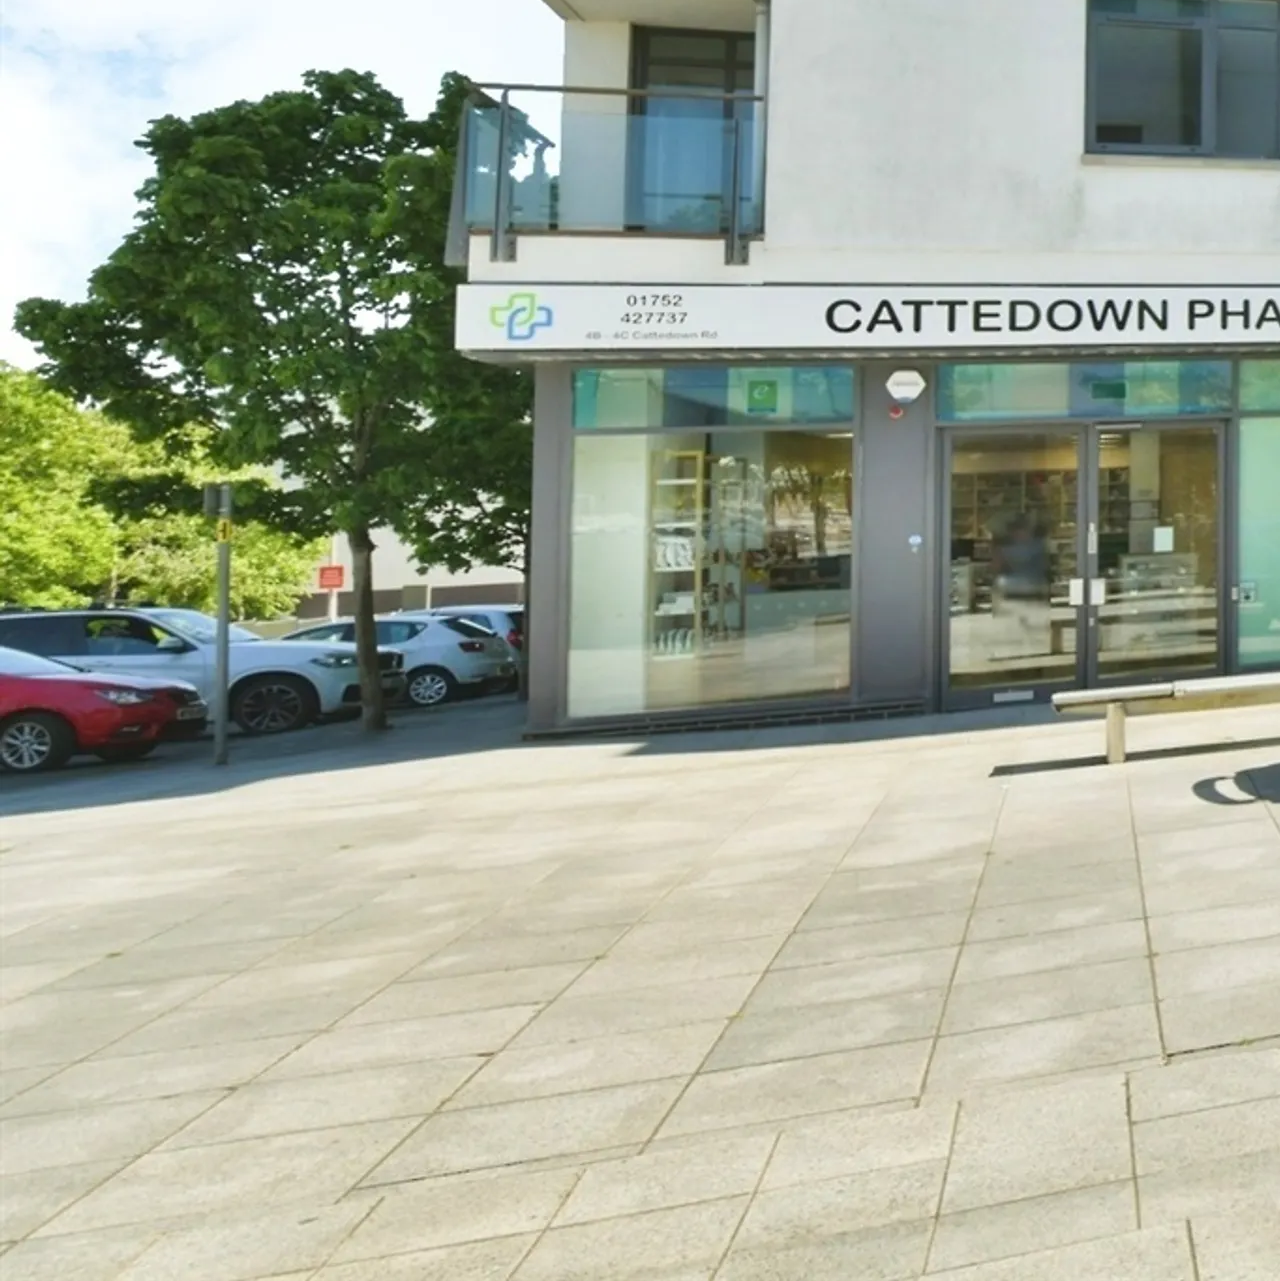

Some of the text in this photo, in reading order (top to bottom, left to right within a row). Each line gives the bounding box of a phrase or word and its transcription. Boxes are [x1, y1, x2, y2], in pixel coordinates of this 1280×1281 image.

[626, 294, 683, 307] 01752
[620, 311, 688, 324] 427737
[825, 298, 1168, 333] CATTEDOWN
[632, 330, 698, 340] Cattedown
[701, 330, 718, 340] Rd
